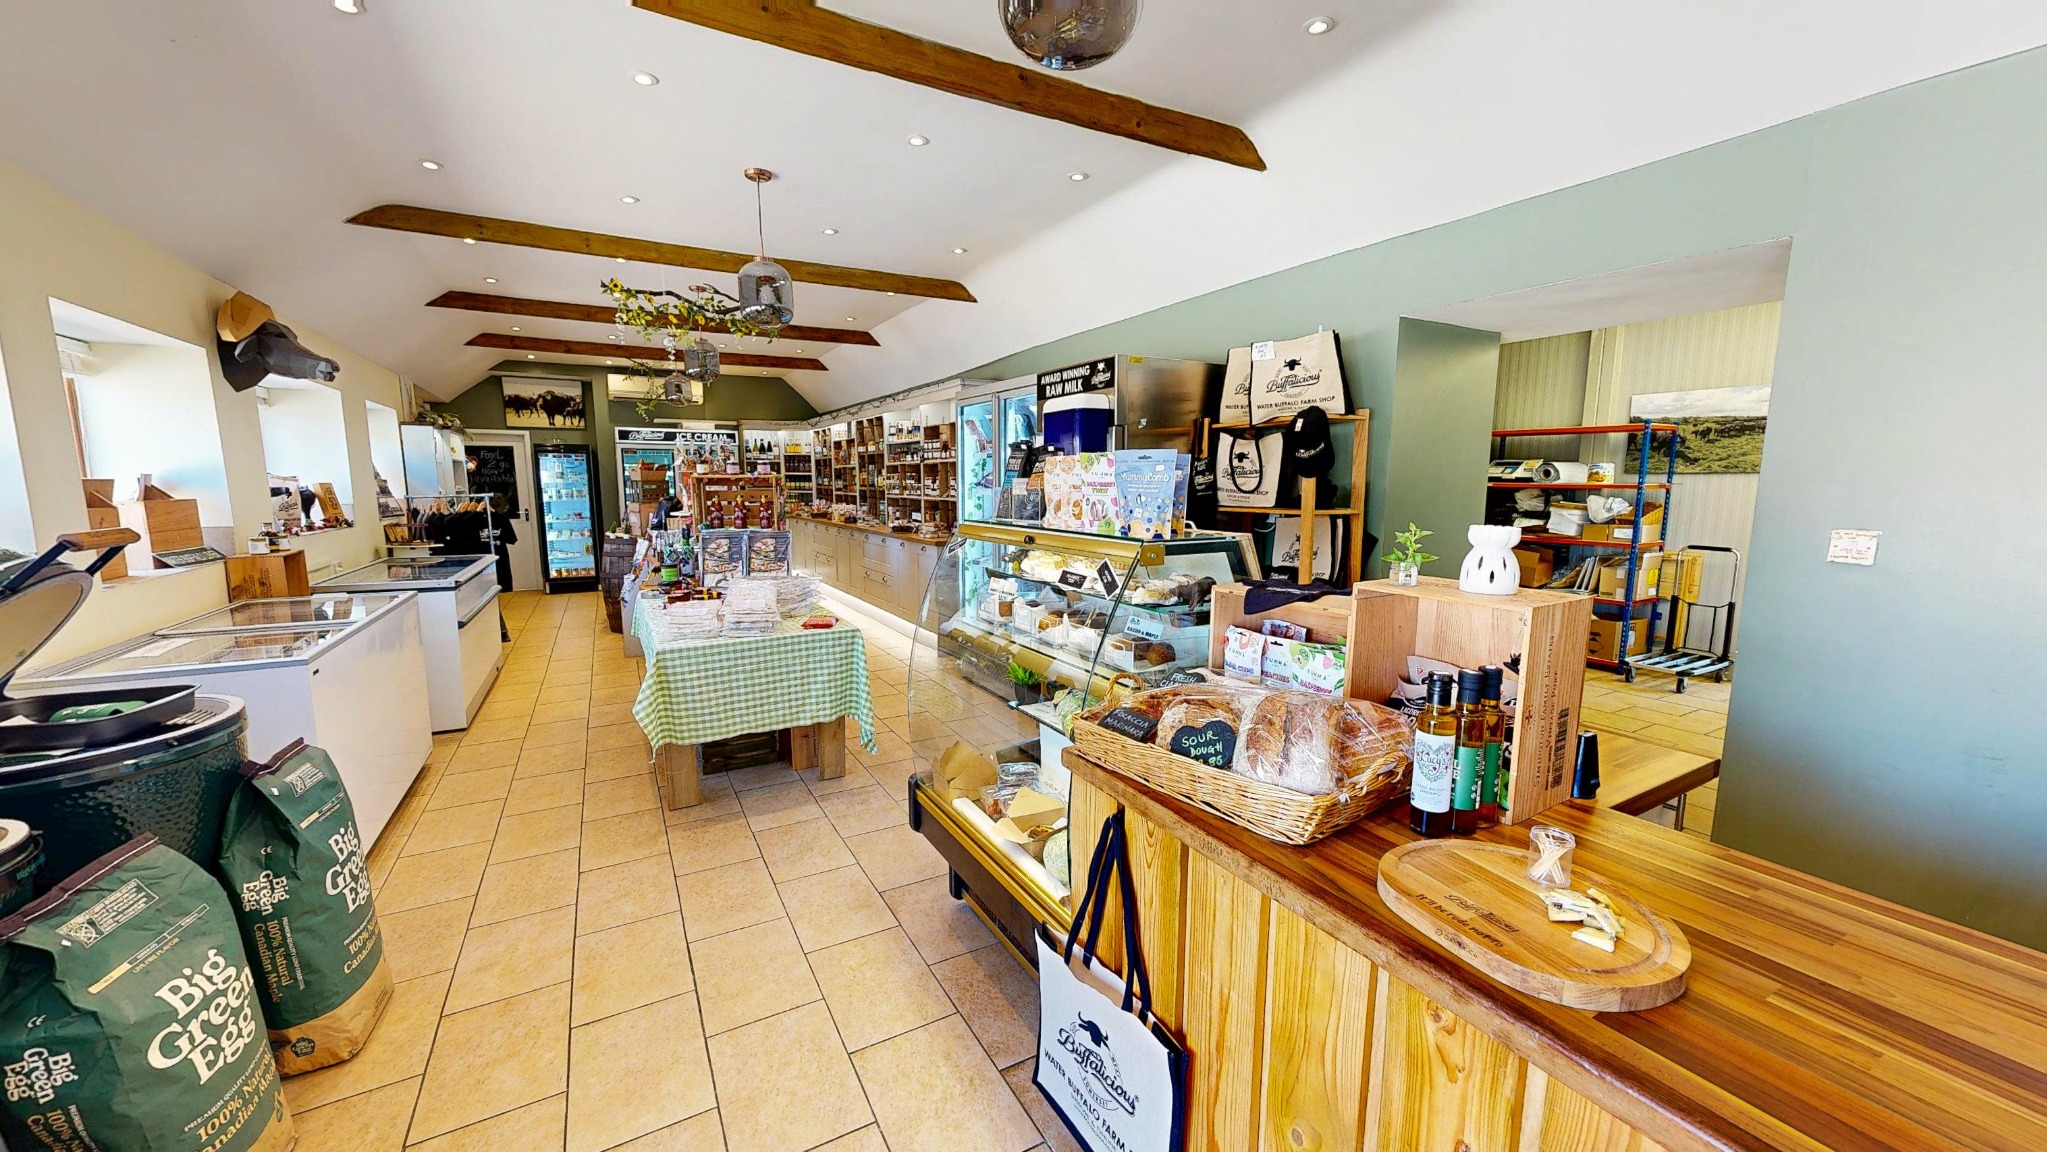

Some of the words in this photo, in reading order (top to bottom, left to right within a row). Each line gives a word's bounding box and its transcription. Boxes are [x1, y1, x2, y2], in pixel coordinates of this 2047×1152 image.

[1041, 372, 1062, 386] AWARD
[1061, 364, 1091, 381] WINNING
[1045, 383, 1064, 398] RAW
[1064, 378, 1084, 394] MILK
[1265, 372, 1321, 394] Buffalicious
[1256, 403, 1274, 411] WATER
[1274, 400, 1299, 409] BUFFALO
[1318, 395, 1336, 403] SHOP
[480, 449, 505, 460] Food
[676, 432, 692, 441] ICE
[694, 433, 728, 442] CREAM
[487, 459, 496, 468] 2
[1120, 472, 1170, 483] YummyComb
[1170, 672, 1198, 685] FRESH
[1112, 708, 1150, 729] FOCACCIA
[1540, 684, 1550, 721] FAMILY
[1103, 716, 1145, 738] MARINARA
[1181, 730, 1219, 748] SOUR
[1189, 741, 1223, 758] DOUGH
[328, 820, 359, 863] Big
[240, 879, 260, 912] Egg
[259, 869, 274, 917] Green
[272, 875, 290, 904] Big
[342, 863, 371, 914] Egg
[266, 919, 283, 948] 100%
[1446, 911, 1471, 928] rude
[253, 923, 273, 973] Canadian
[154, 948, 238, 1020] Big
[273, 948, 295, 987] Natural
[146, 965, 255, 1070] Green
[187, 996, 256, 1086] Egg
[2, 1060, 36, 1102] Egg
[22, 1046, 56, 1106] Green
[48, 1051, 80, 1088] Big
[1056, 1026, 1137, 1118] Buffalicious
[183, 1098, 224, 1134] PREMIUM
[222, 1072, 247, 1101] QUALITY
[195, 1094, 244, 1144] 100%
[241, 1045, 273, 1100] Natural
[1043, 1046, 1067, 1081] WATER
[1066, 1075, 1101, 1122] BUFFALO
[1100, 1116, 1127, 1152] FARM
[194, 1094, 260, 1152] anadian
